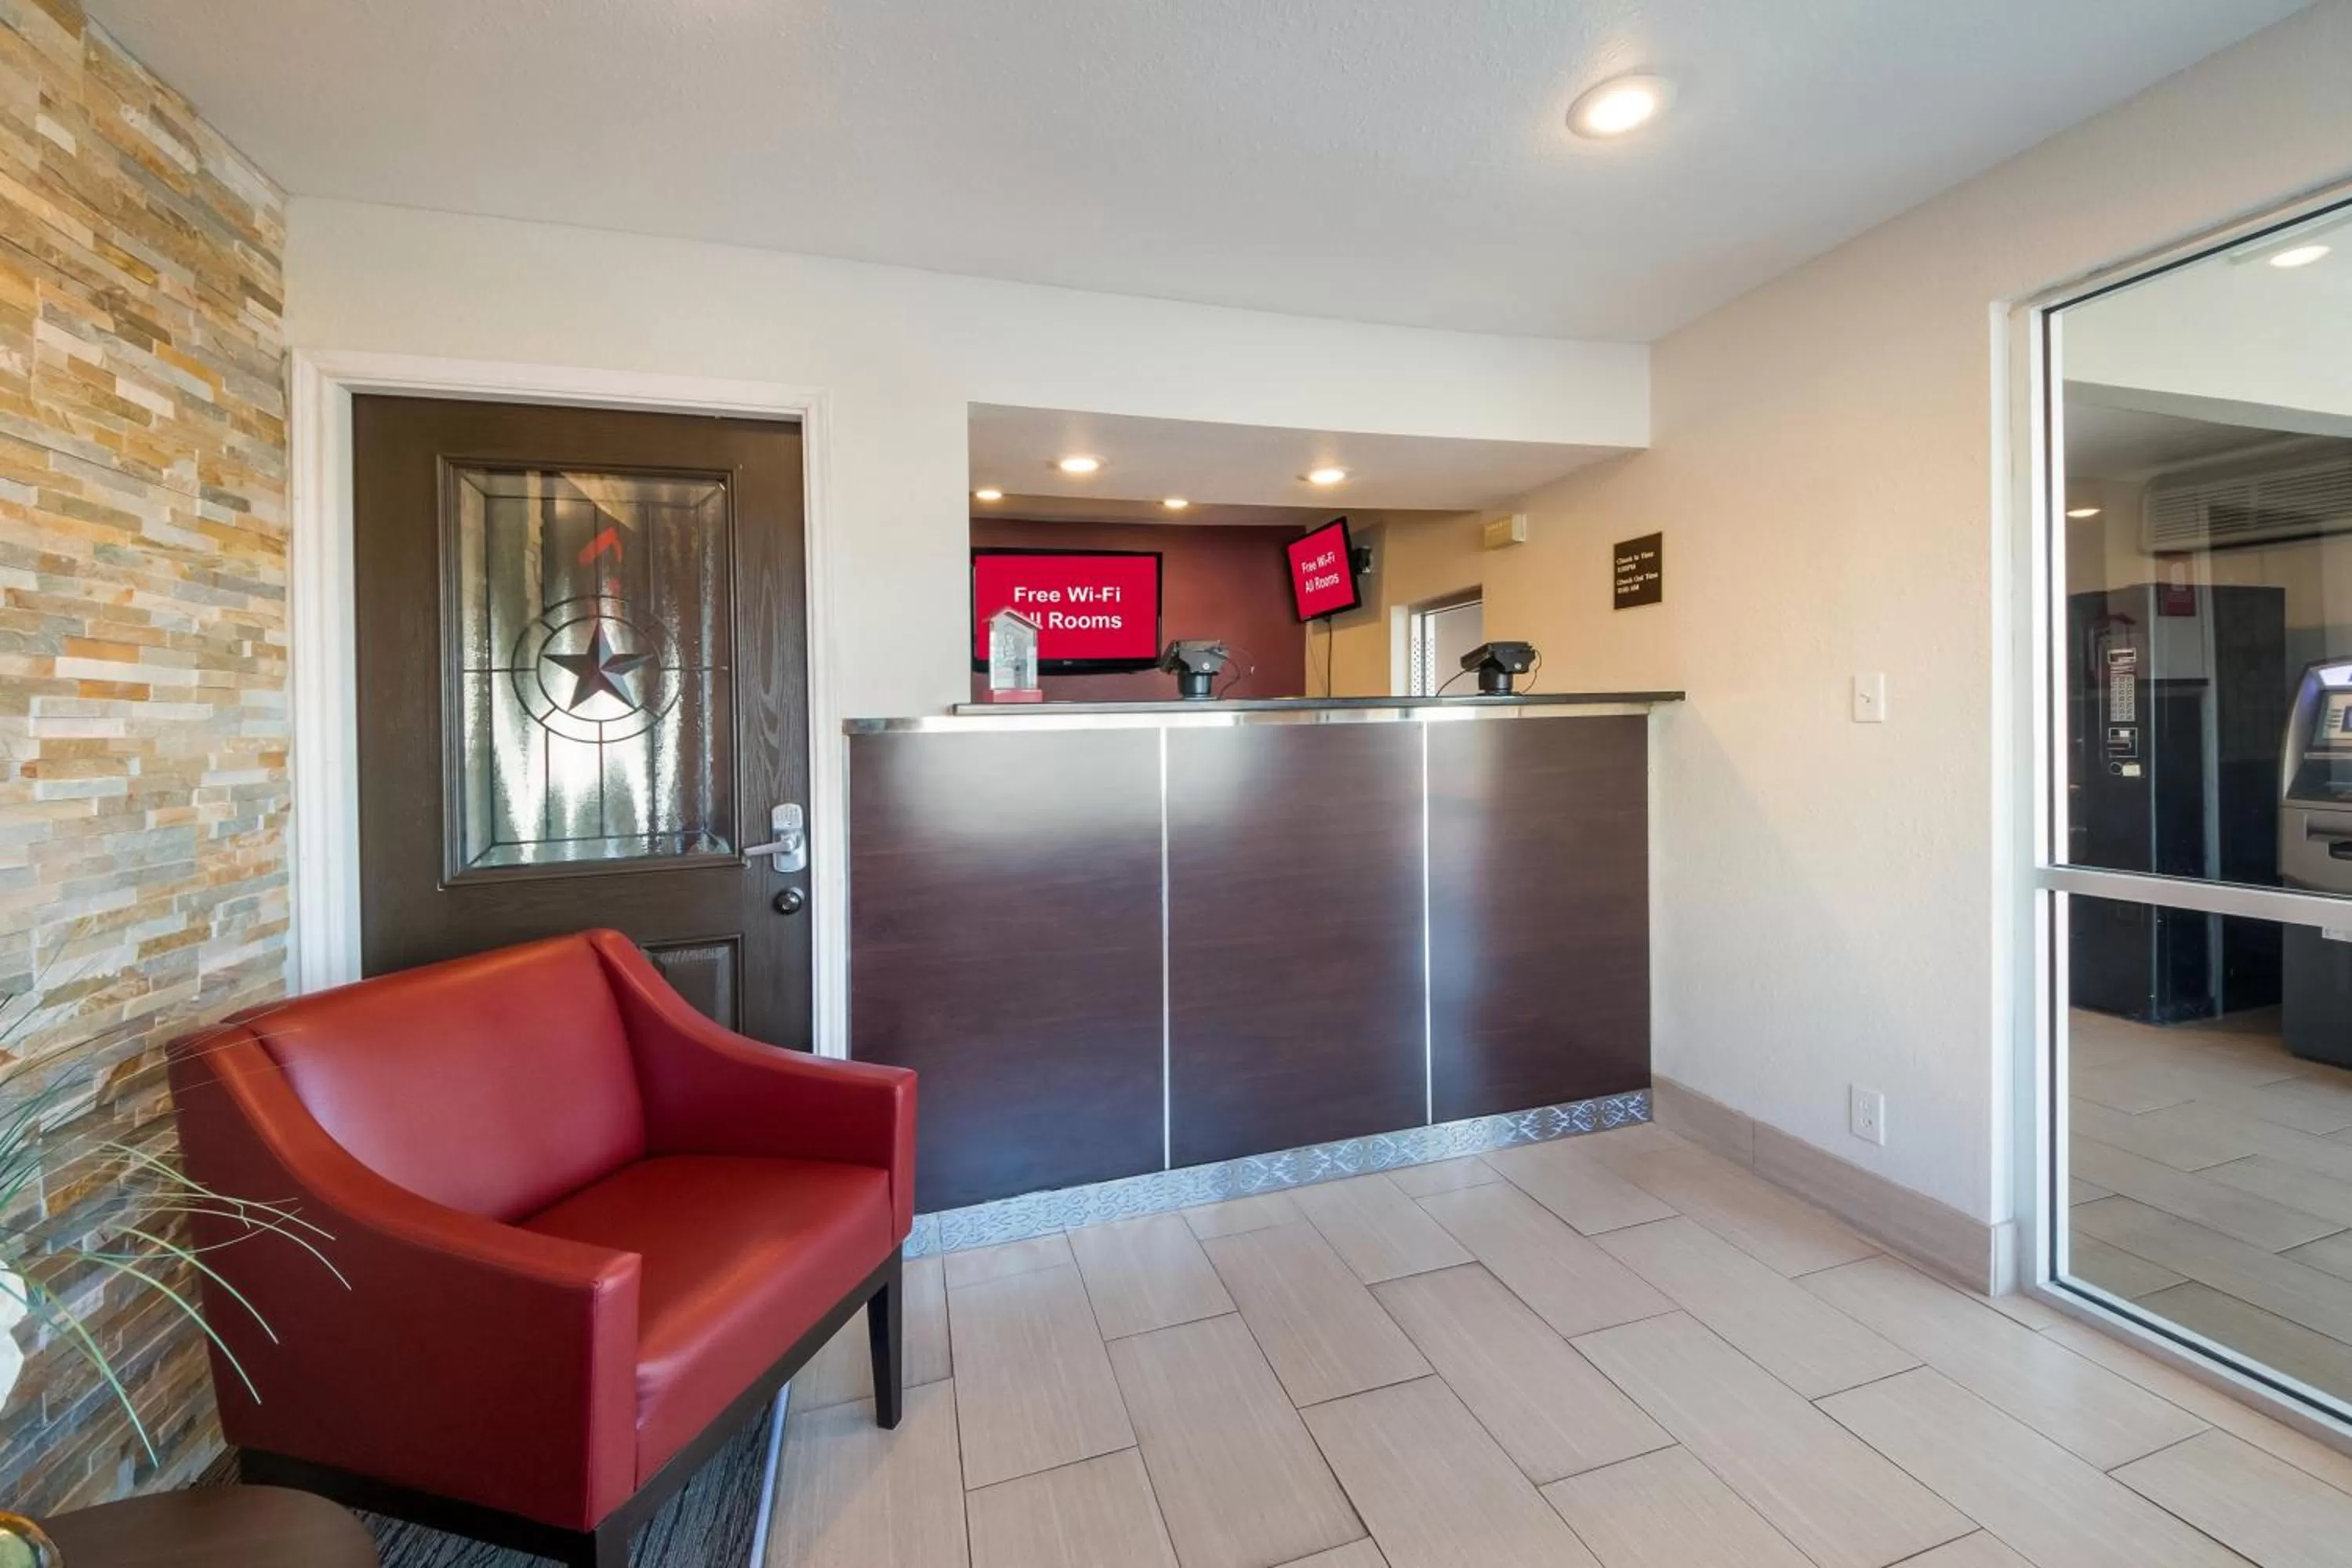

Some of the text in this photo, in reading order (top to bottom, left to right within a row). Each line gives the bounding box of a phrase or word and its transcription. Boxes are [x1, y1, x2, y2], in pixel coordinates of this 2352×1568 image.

[1301, 551, 1335, 574] Free Wi-Fi
[1314, 573, 1340, 590] Rooms
[1014, 586, 1121, 603] Free Wi-Fi
[1048, 612, 1122, 629] Rooms
